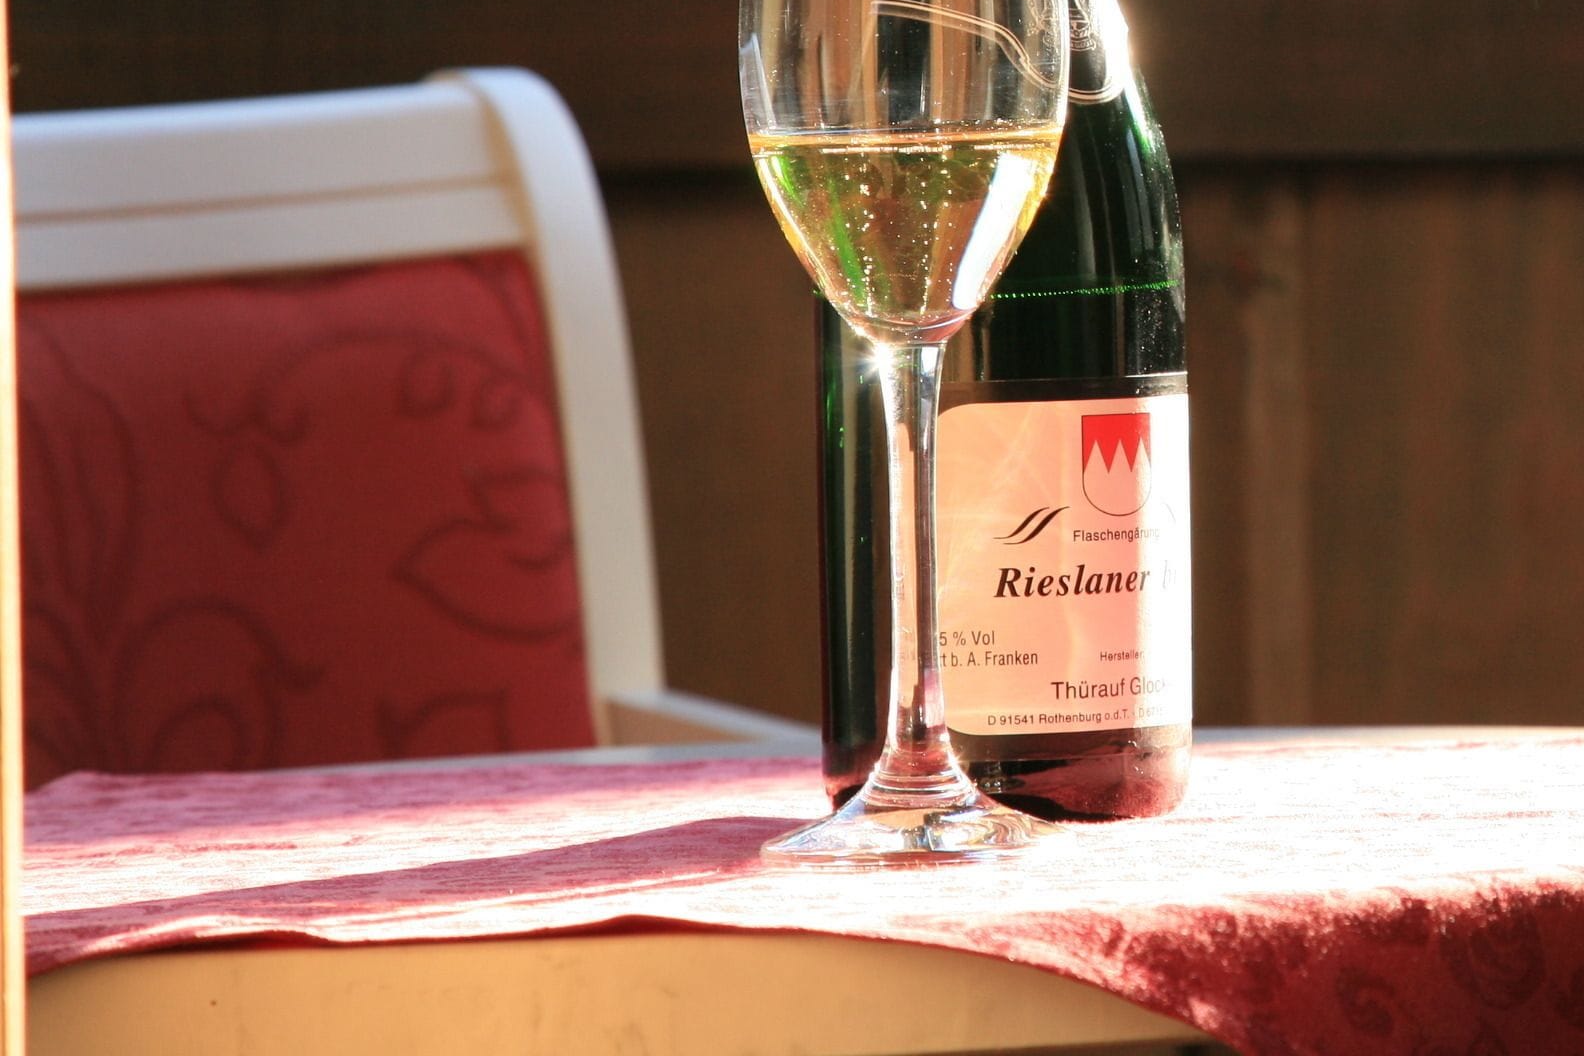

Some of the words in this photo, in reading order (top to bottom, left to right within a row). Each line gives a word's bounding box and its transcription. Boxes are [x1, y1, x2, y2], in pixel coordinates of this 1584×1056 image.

[993, 564, 1151, 598] Rieslaner
[971, 630, 995, 645] Vol
[951, 651, 963, 667] b.
[967, 651, 980, 667] A.
[984, 650, 1038, 666] Franken
[1051, 678, 1126, 700] Thürauf
[987, 715, 997, 726] D
[1000, 714, 1034, 726] 91541
[1039, 711, 1102, 724] Rothenburg
